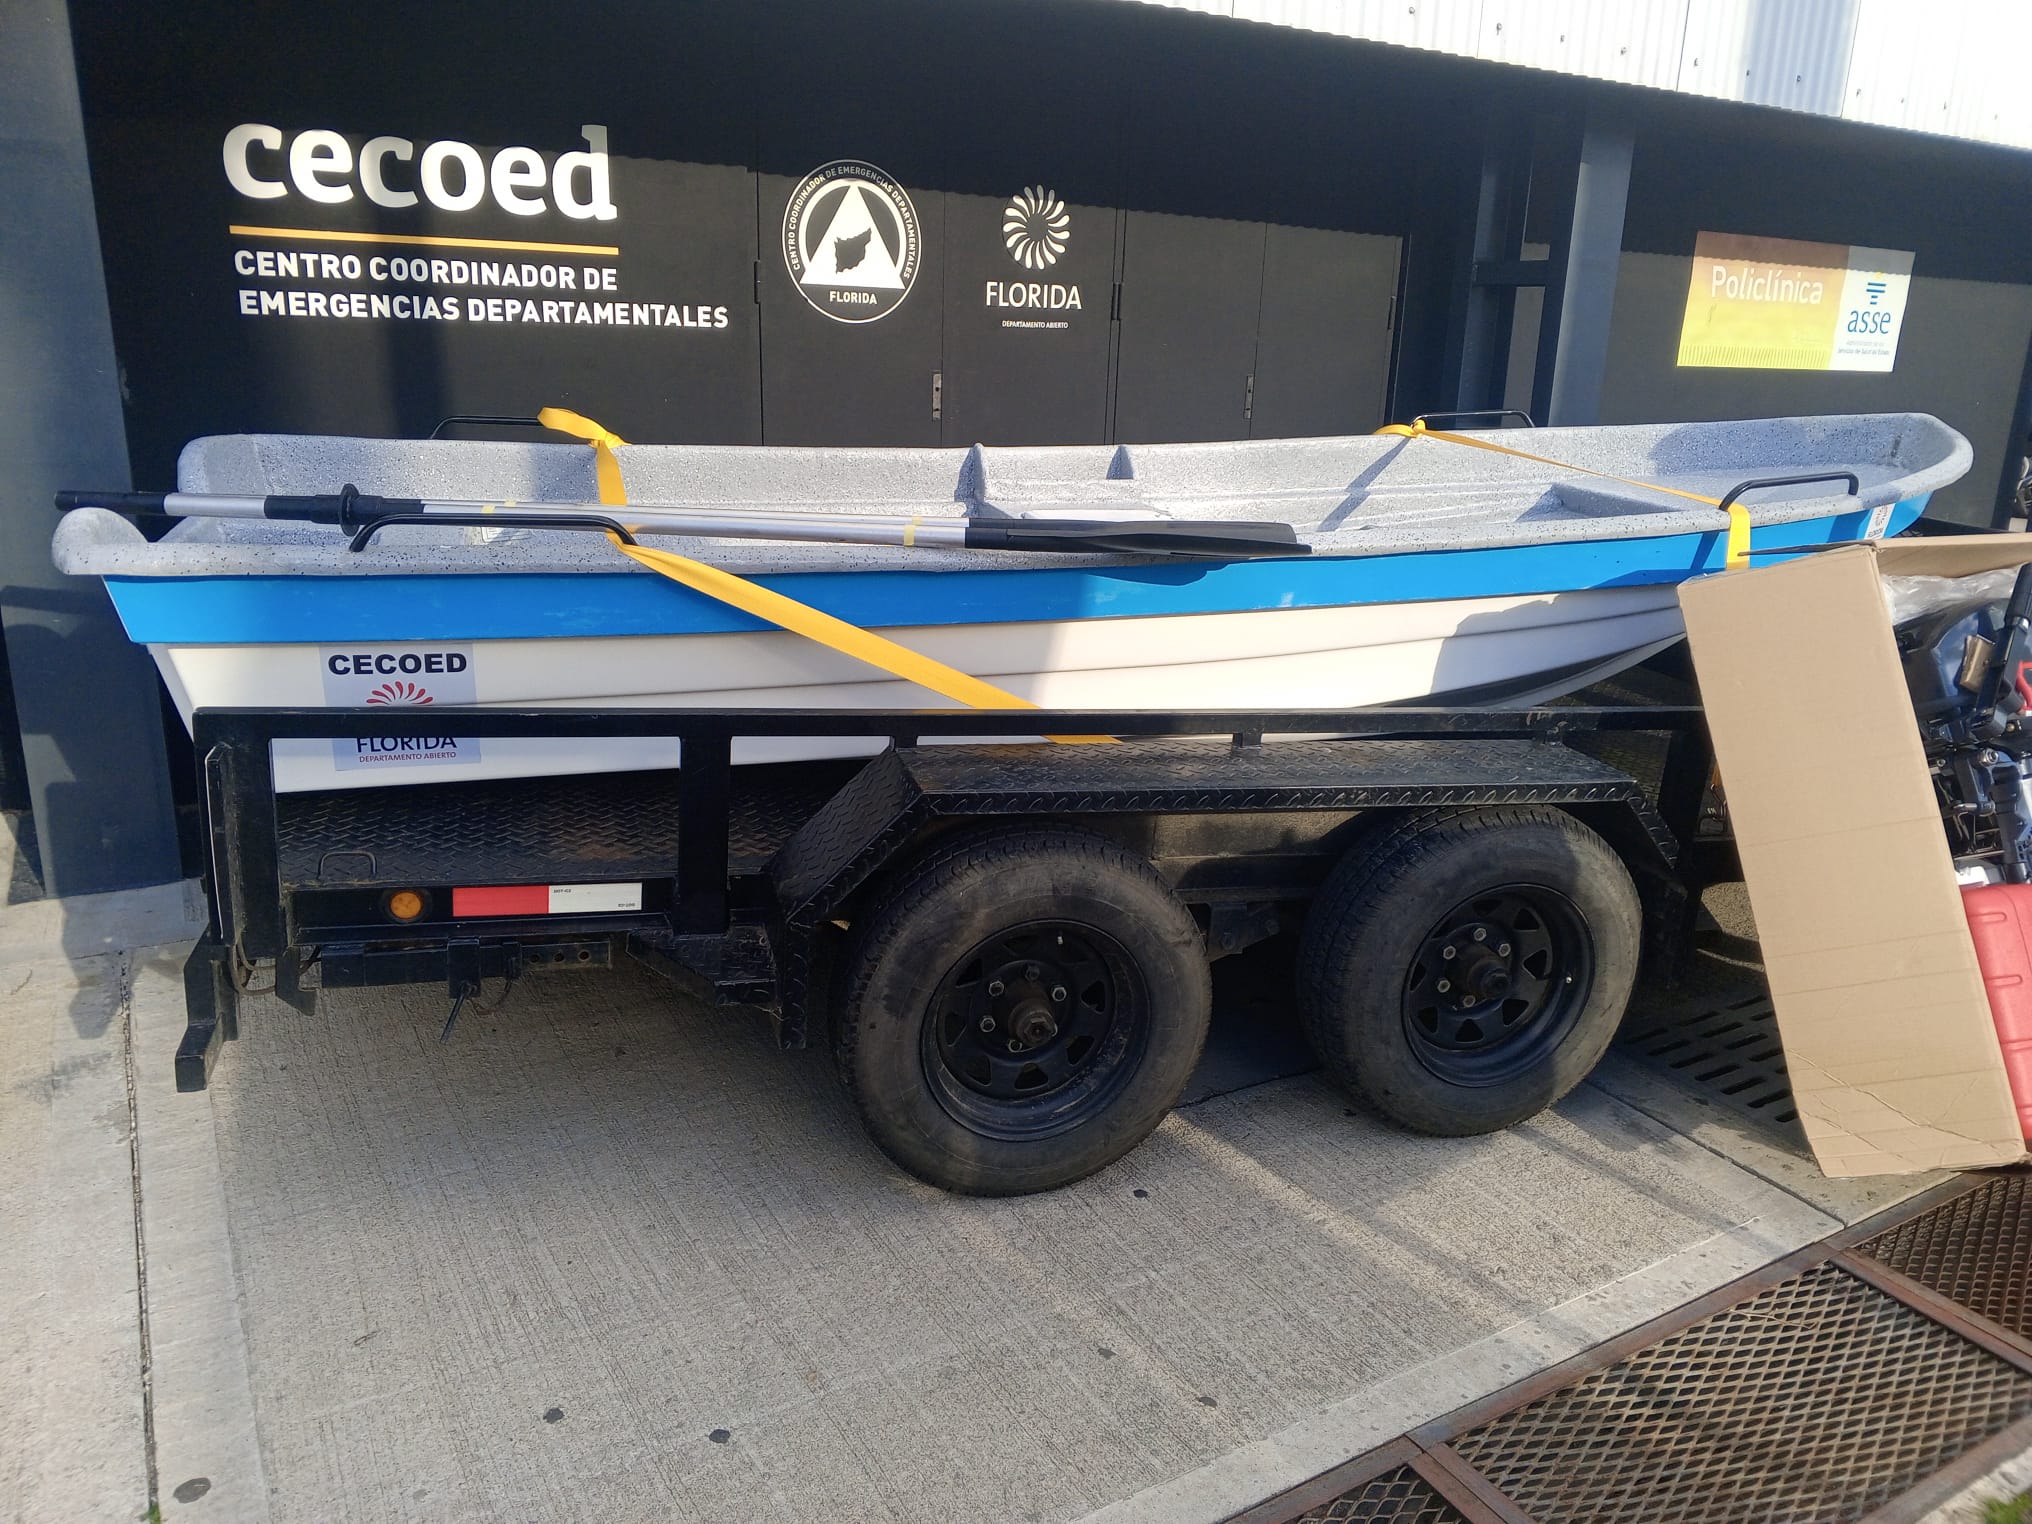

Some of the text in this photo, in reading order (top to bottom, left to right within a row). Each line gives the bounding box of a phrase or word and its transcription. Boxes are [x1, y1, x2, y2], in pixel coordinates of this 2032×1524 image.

[223, 123, 617, 220] cecoed
[787, 166, 917, 280] CENTRO COORDINADOR DE EMERGENCIAS DEPARTAMENTALES
[234, 250, 617, 290] CENTRO COORDINADOR DE
[829, 290, 877, 305] FLORIDA
[986, 281, 1082, 310] FLORIDA
[1711, 265, 1824, 304] Policlínica
[239, 289, 730, 329] EMERGENCIAS DEPARTAMENTALES
[1847, 309, 1891, 335] asse
[1002, 320, 1069, 329] DEPARTAMENTO ABIERTO
[328, 653, 467, 675] CECOED
[356, 736, 457, 753] FLORIDA
[359, 751, 457, 763] DEPARTAMENTO ABIERTO
